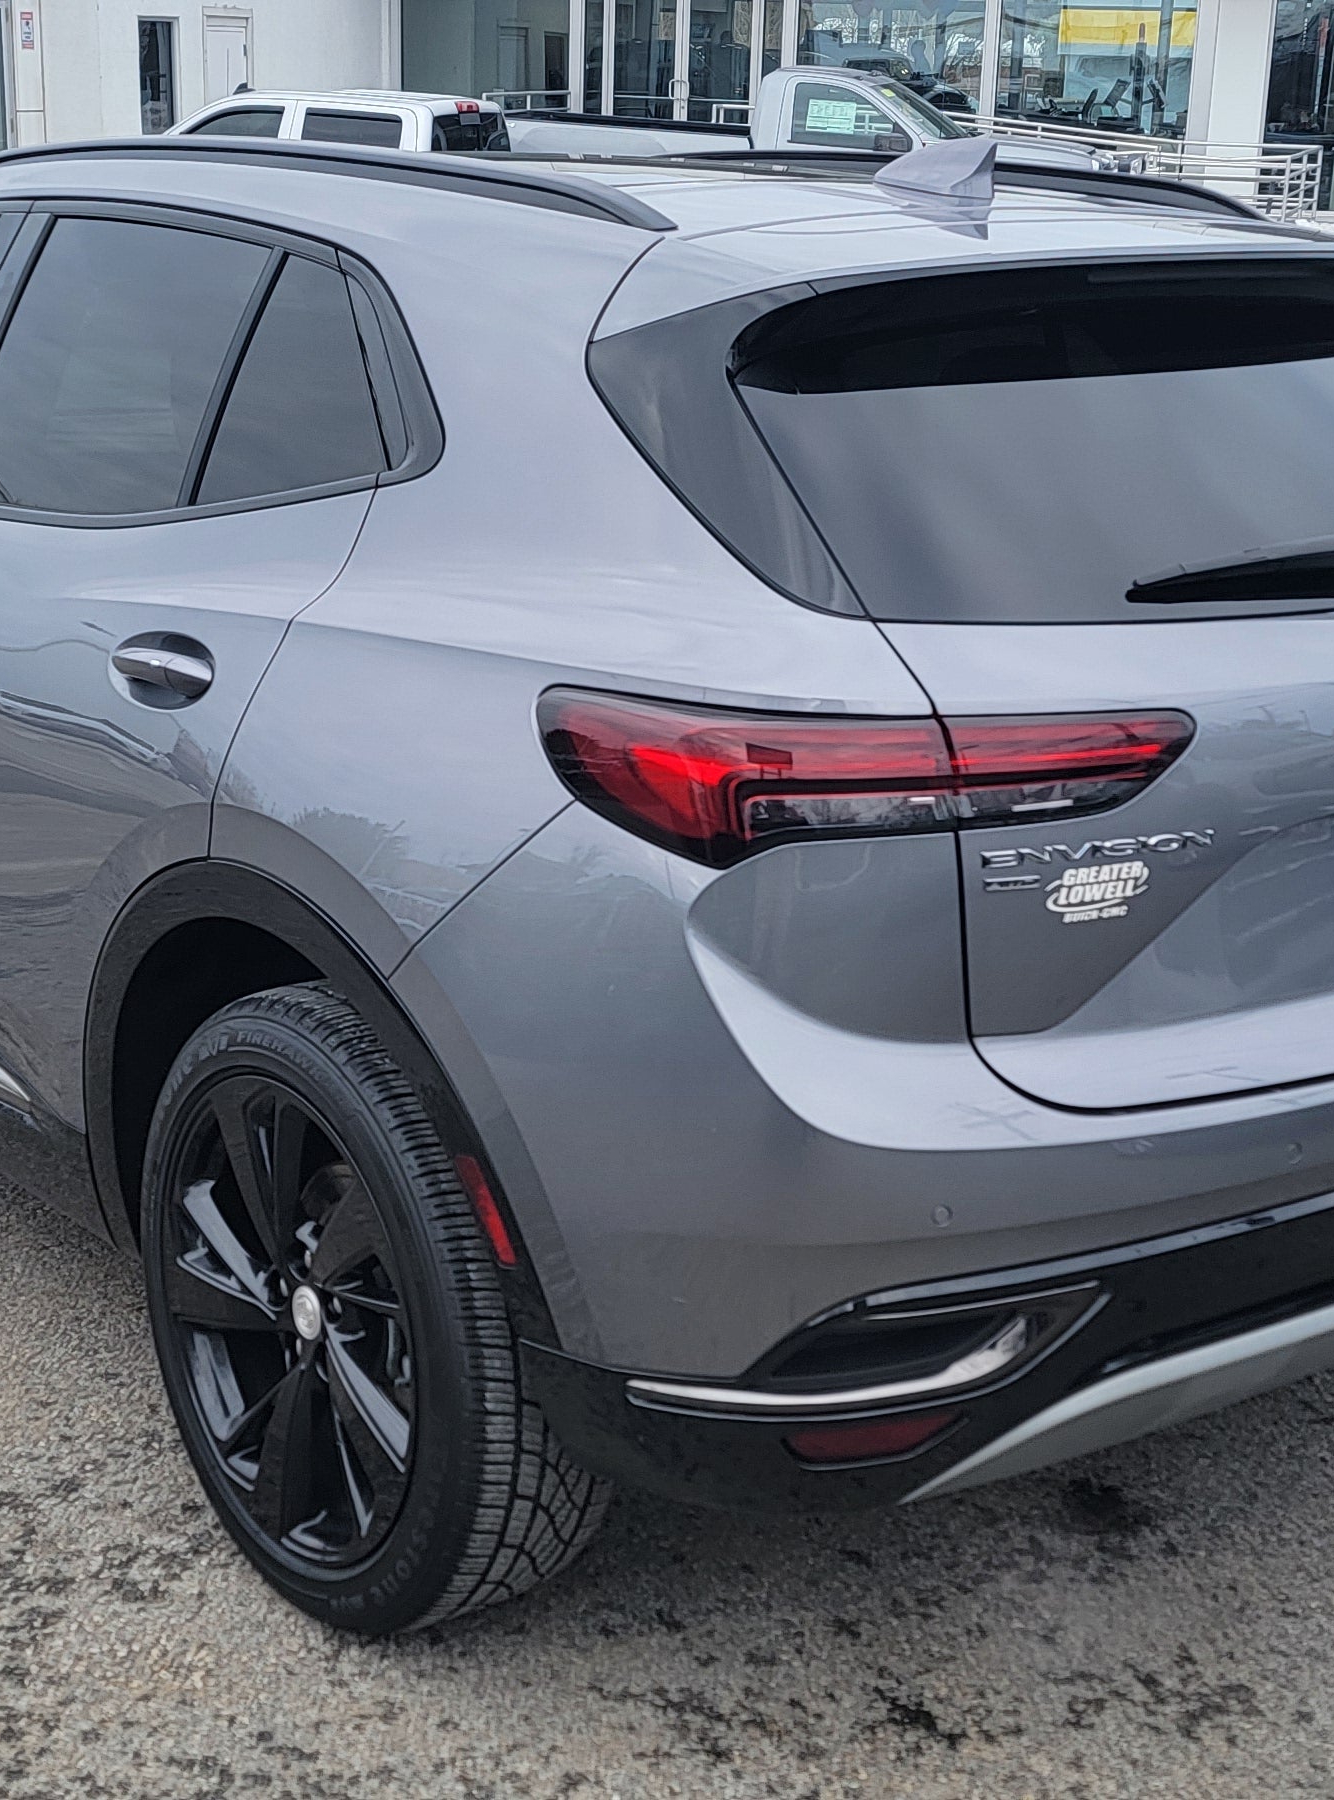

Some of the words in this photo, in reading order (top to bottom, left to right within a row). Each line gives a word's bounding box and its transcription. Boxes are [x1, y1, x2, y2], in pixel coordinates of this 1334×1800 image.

[980, 829, 1215, 868] ENVISION
[1062, 861, 1144, 886] GREATER
[1056, 879, 1136, 905] LOWELL
